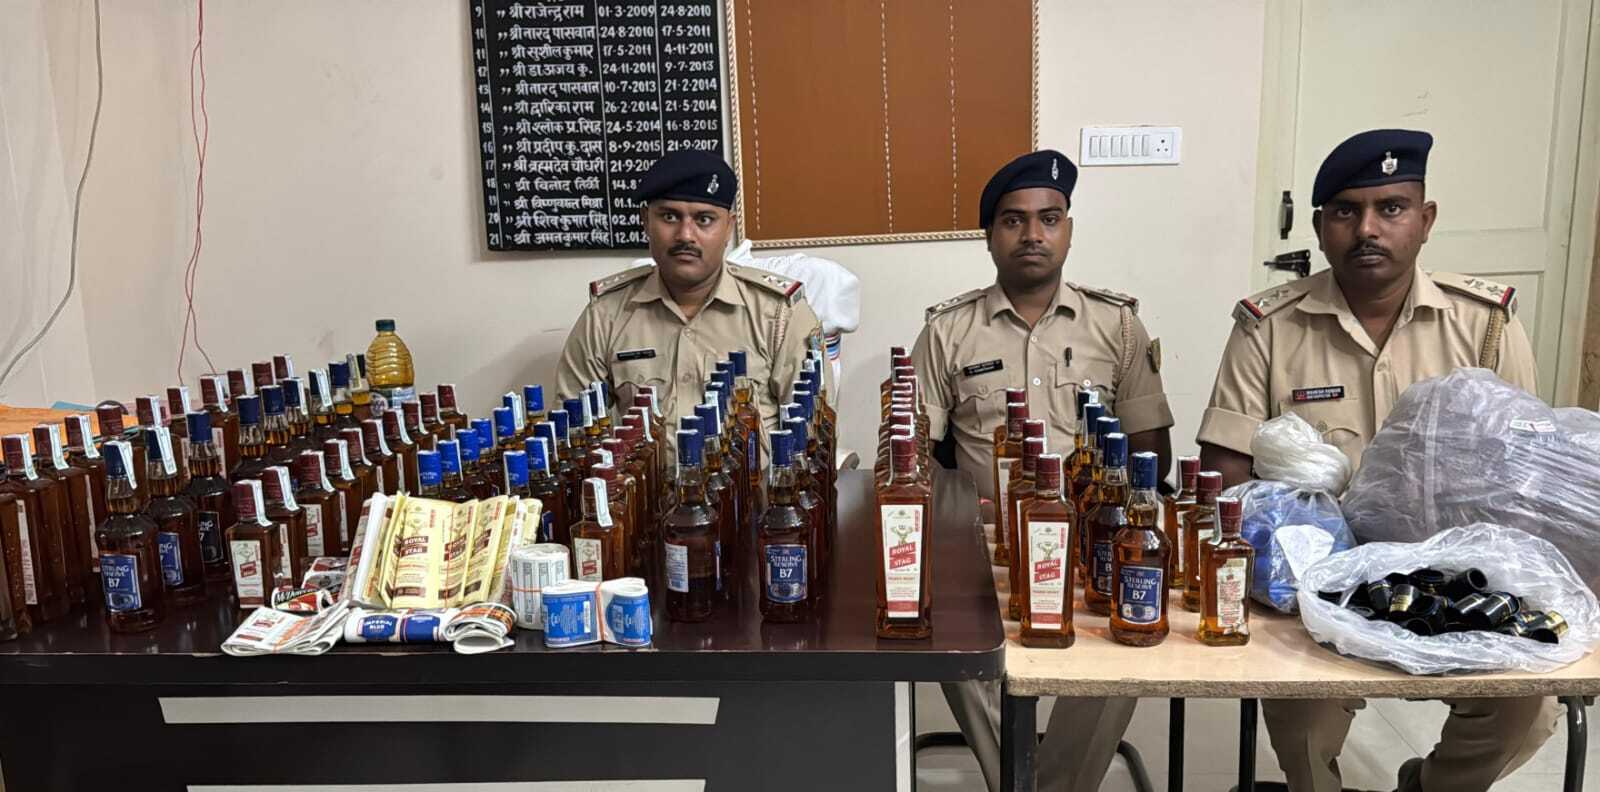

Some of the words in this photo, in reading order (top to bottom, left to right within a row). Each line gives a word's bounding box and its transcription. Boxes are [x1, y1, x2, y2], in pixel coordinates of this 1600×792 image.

[562, 5, 584, 19] राम
[562, 45, 594, 60] कुमार
[572, 101, 595, 115] राम
[891, 543, 914, 555] ROYAL
[893, 558, 912, 568] STAG
[1037, 560, 1059, 570] ROYAL
[779, 568, 793, 578] B7
[108, 577, 121, 588] B7
[1123, 574, 1157, 585] STERLING
[1132, 589, 1147, 601] B7
